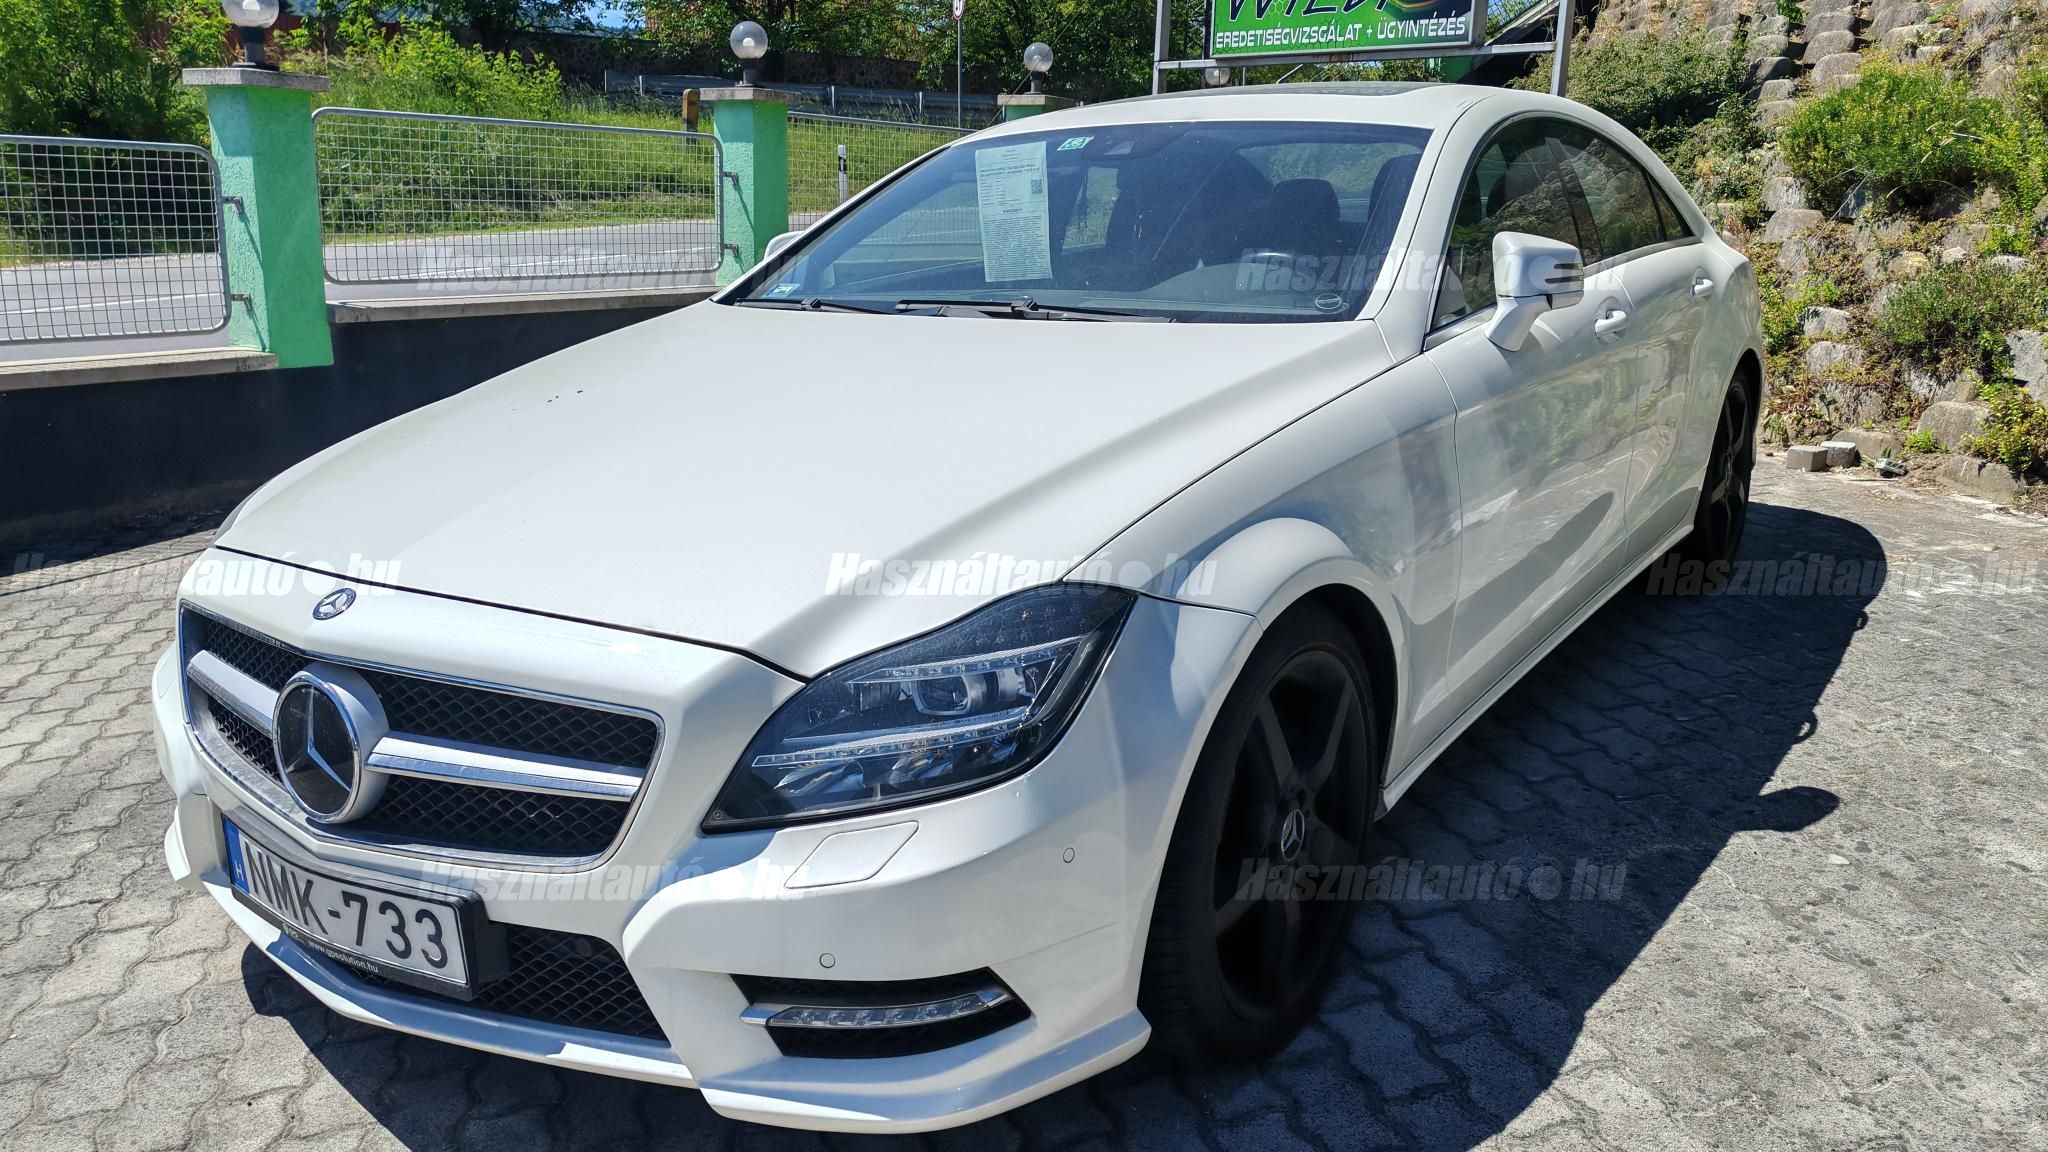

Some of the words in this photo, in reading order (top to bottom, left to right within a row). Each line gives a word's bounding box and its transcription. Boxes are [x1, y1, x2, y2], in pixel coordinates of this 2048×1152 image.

[1216, 20, 1363, 49] EREDETISÉGVIZSGÁLAT
[1377, 11, 1467, 40] ÜGYINTÉZÉS
[236, 862, 245, 882] H
[245, 840, 448, 970] NMK-733
